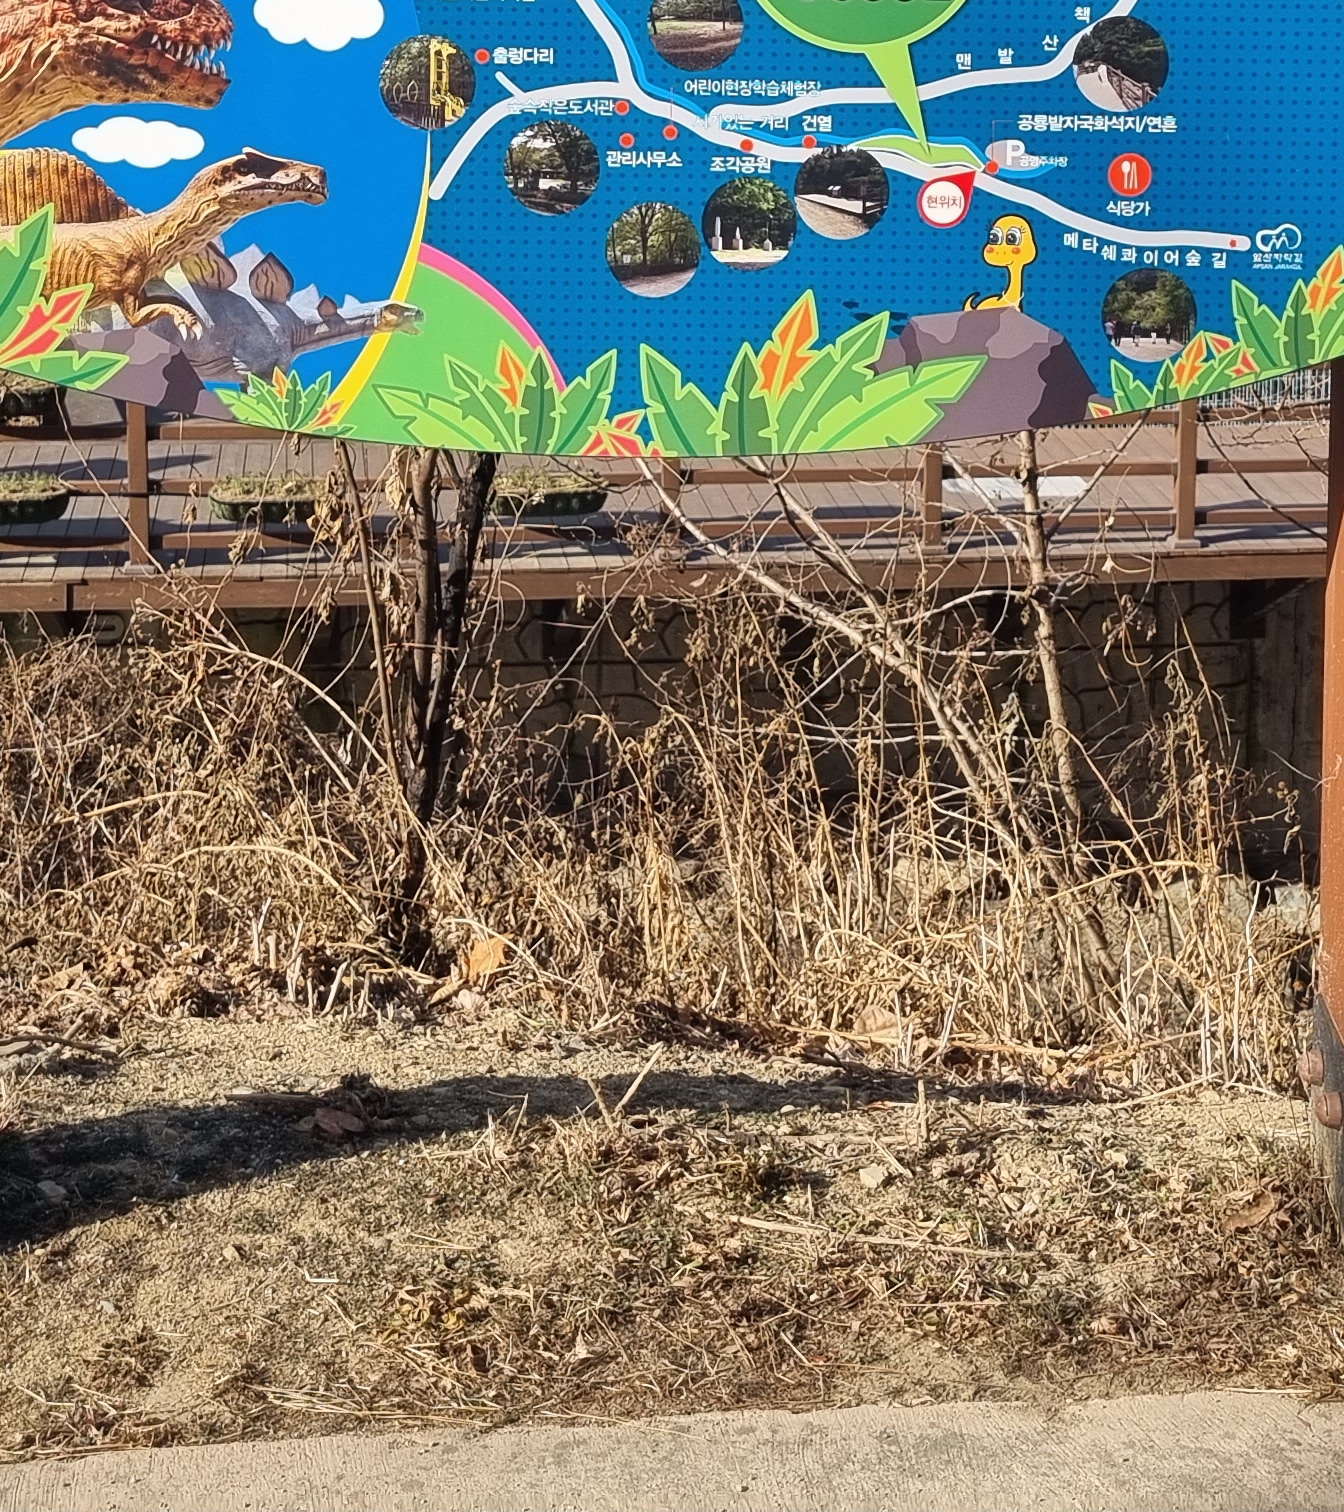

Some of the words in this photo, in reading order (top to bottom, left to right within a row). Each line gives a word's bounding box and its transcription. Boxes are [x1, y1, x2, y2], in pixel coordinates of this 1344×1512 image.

[493, 47, 554, 65] 출렁다리
[684, 79, 821, 97] 어린이현장학습체험장
[759, 114, 789, 131] 거리
[801, 114, 833, 133] 건열
[606, 150, 683, 169] 관리사무소
[1006, 140, 1026, 166] P
[1019, 155, 1068, 168] 공영주차장
[710, 155, 771, 173] 조각공원
[926, 194, 962, 211] 현위치
[1106, 200, 1151, 217] 식당가
